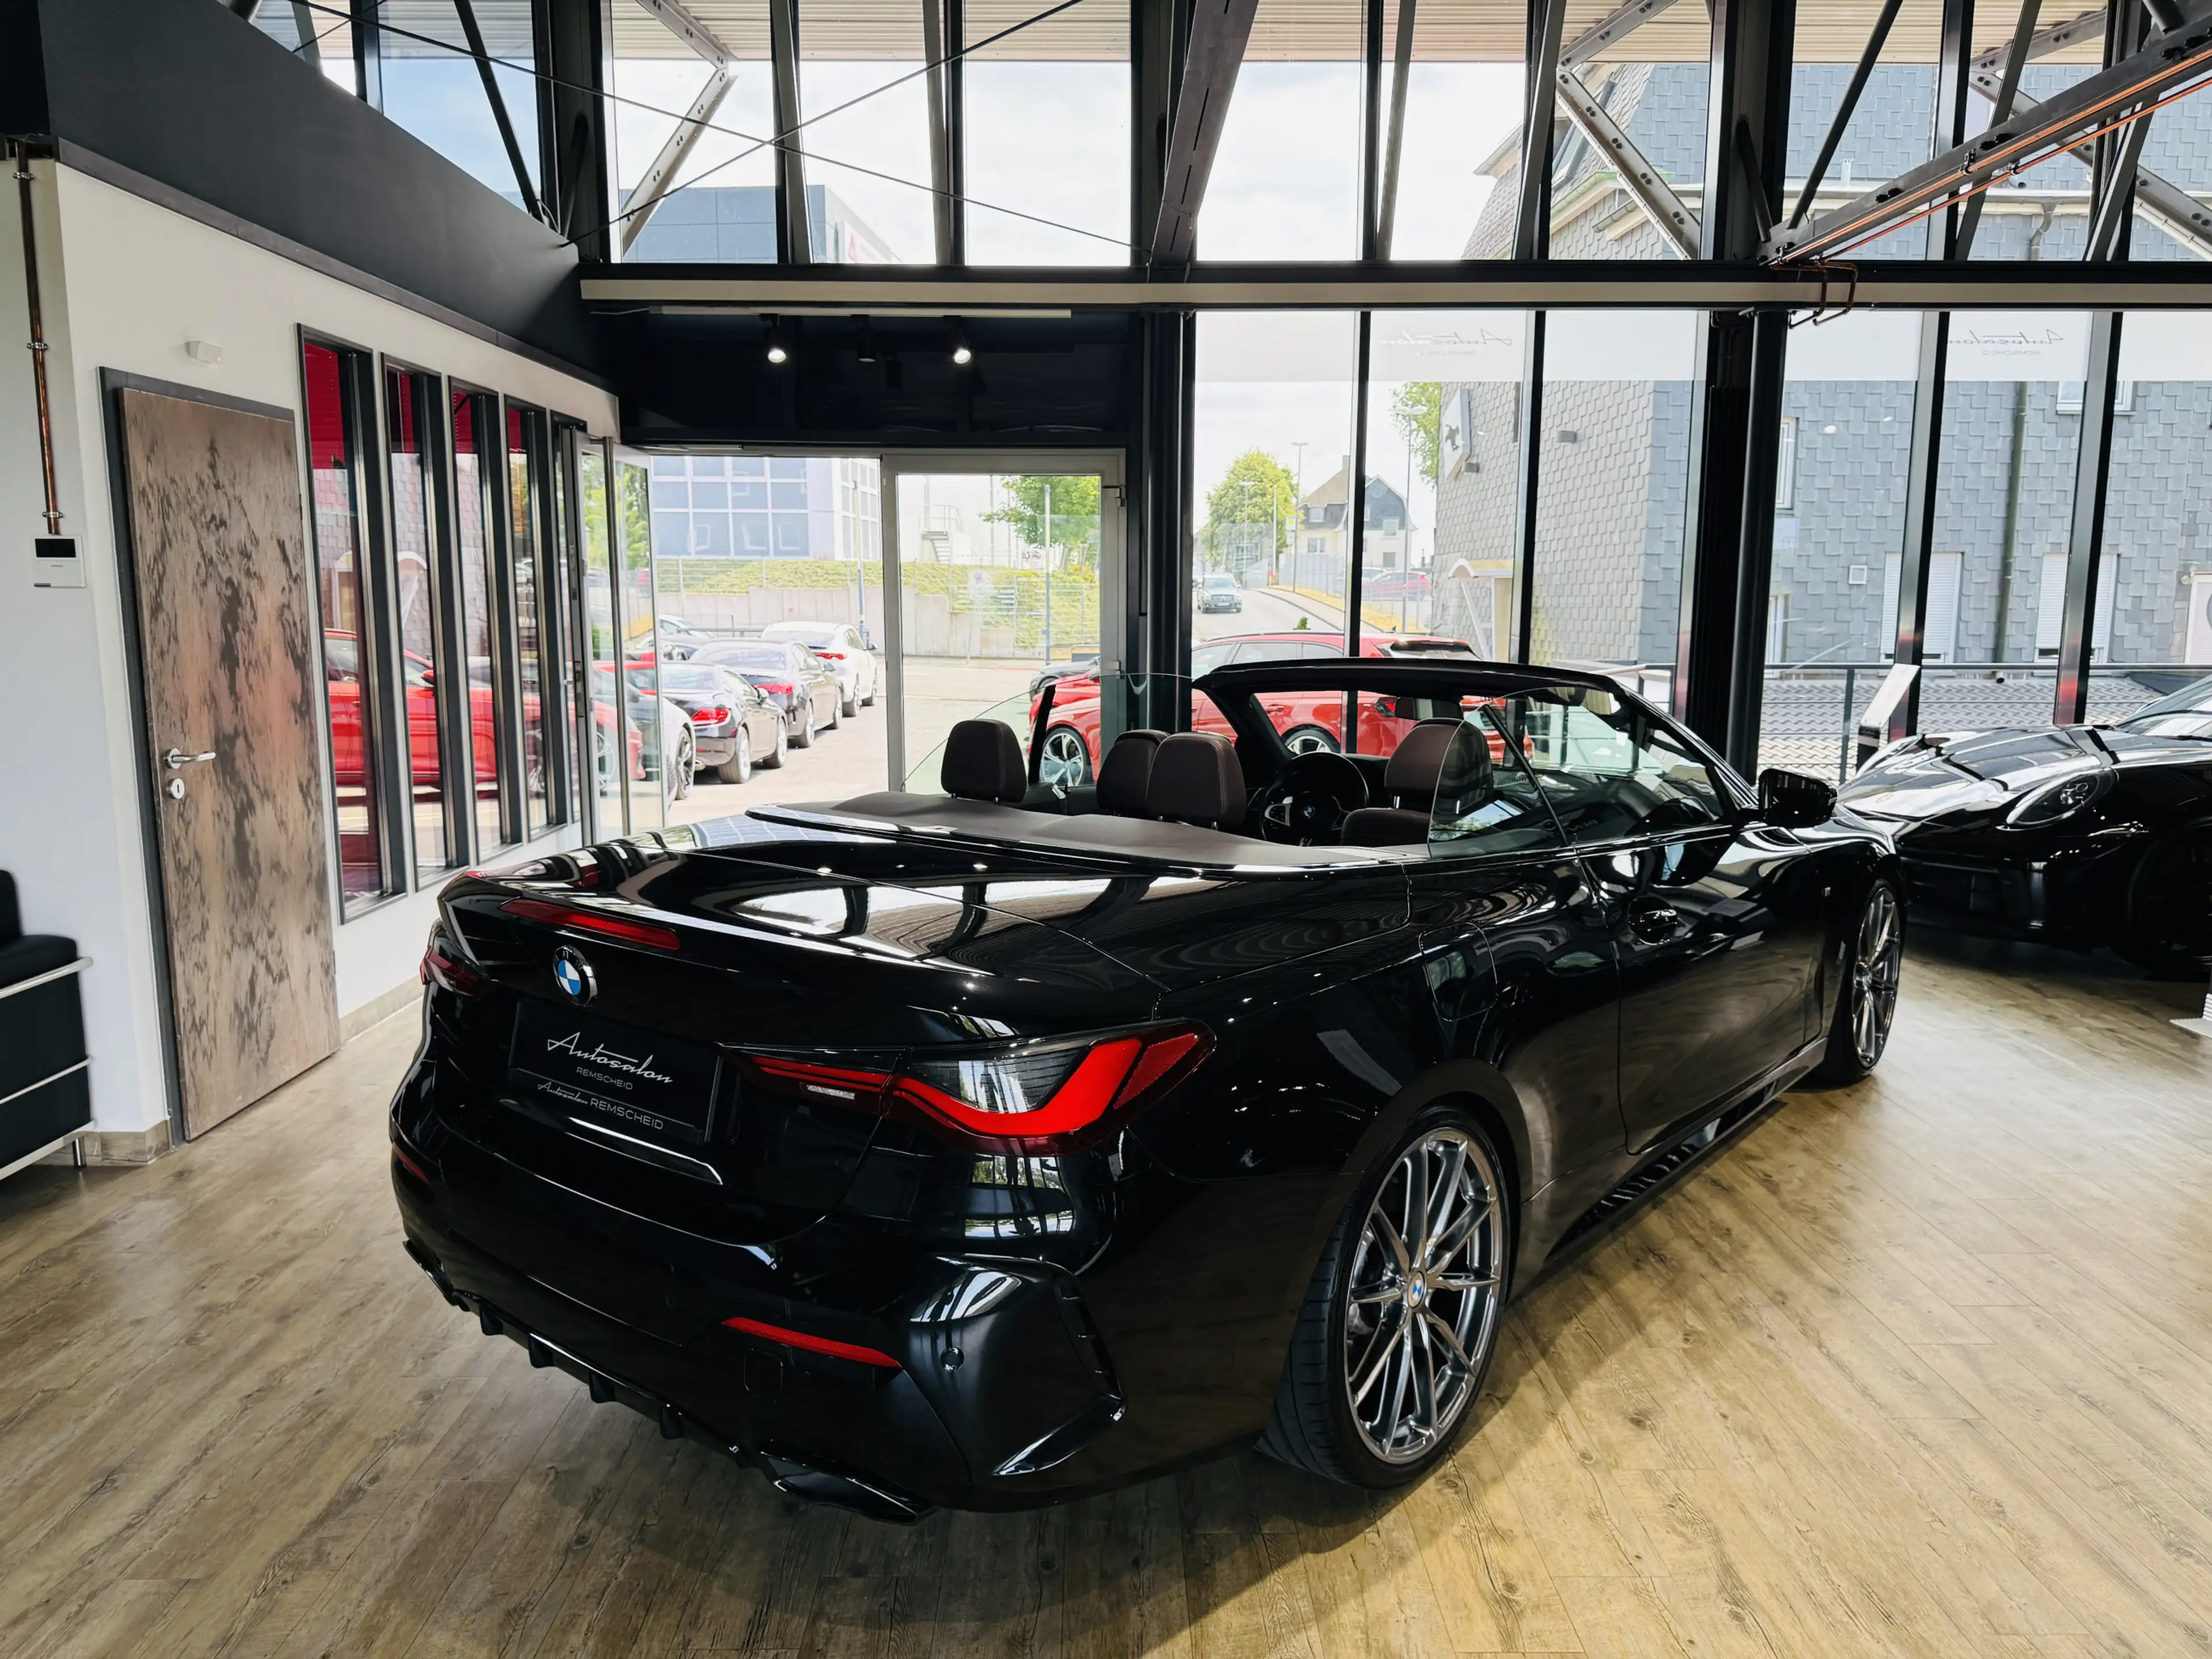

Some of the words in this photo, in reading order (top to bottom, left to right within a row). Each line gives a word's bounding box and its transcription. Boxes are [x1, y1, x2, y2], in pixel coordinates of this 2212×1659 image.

[547, 1032, 673, 1083] Autosalon
[576, 1067, 633, 1090] REMSCHEID
[537, 1082, 588, 1104] Autosalon
[590, 1097, 664, 1130] REMSCHEID
